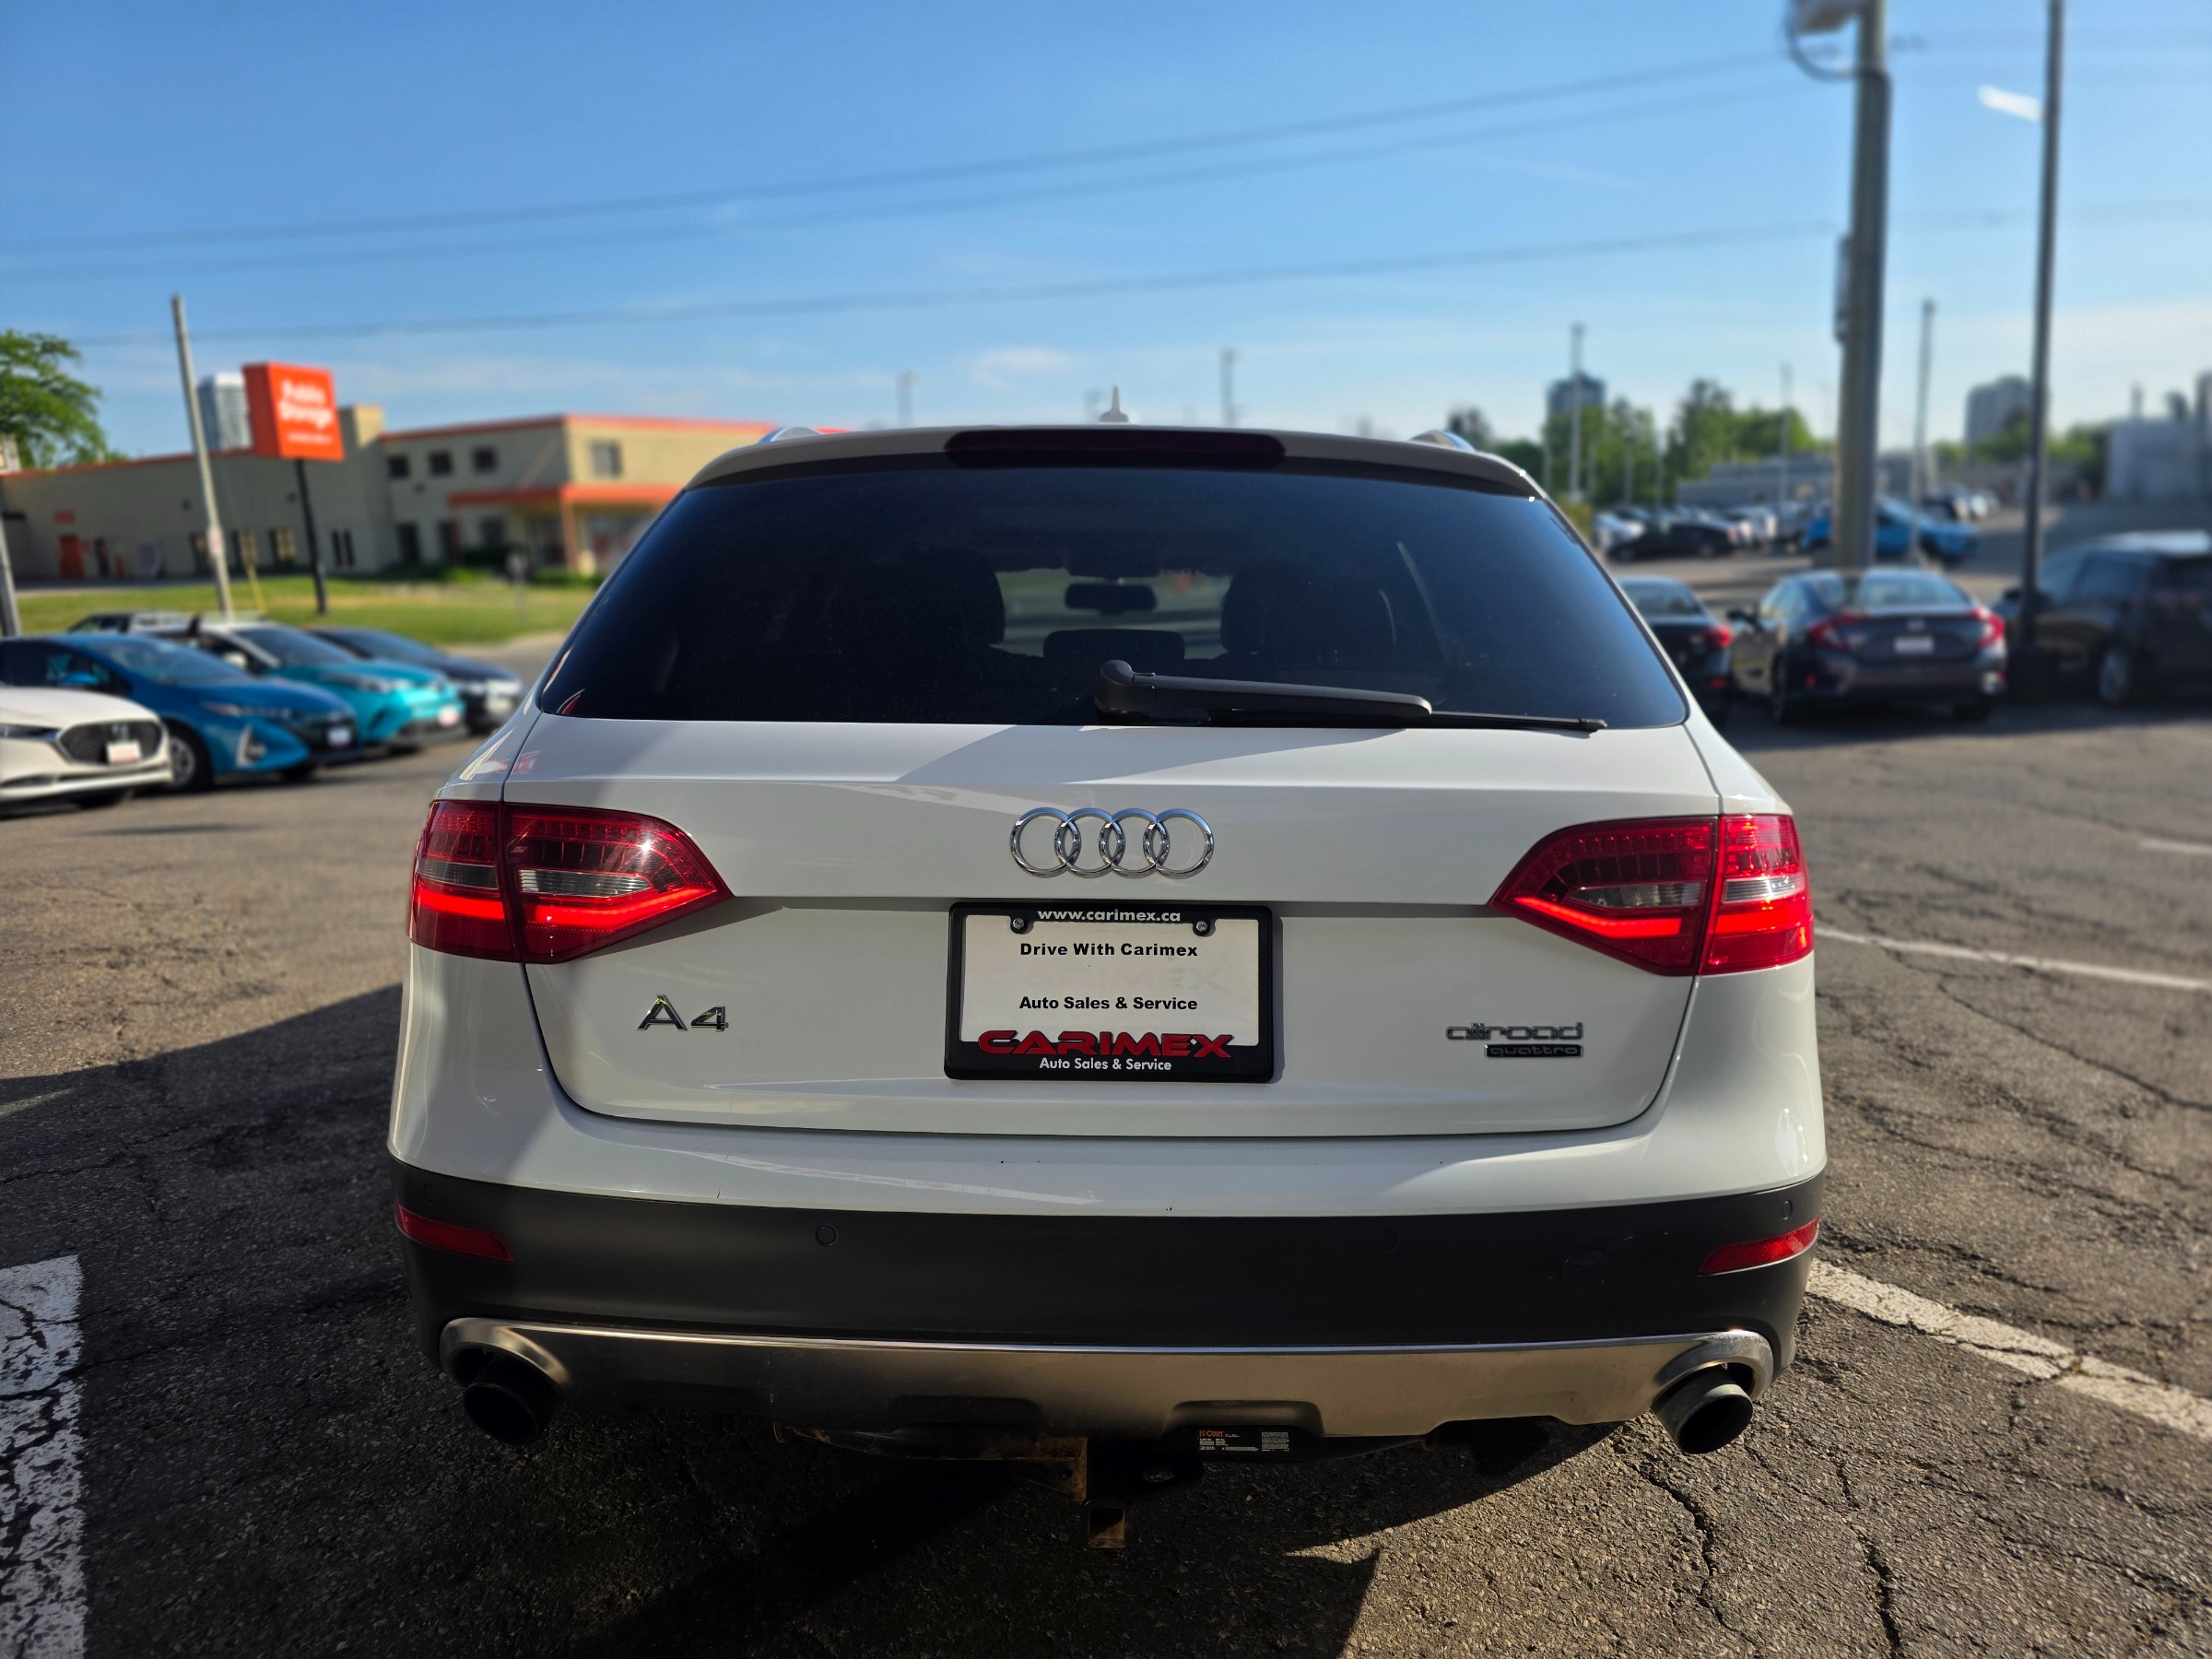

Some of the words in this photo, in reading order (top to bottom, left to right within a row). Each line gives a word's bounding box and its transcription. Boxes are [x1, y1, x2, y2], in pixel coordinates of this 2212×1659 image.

[1037, 909, 1181, 922] www.carimex.ca
[1020, 943, 1068, 956] Drive
[1073, 943, 1115, 956] With
[1120, 943, 1198, 957] Carimex
[1019, 996, 1059, 1009] Auto
[1064, 996, 1110, 1009] Sales
[1115, 996, 1128, 1009] &
[1133, 997, 1198, 1010] Service
[637, 994, 729, 1032] A4
[978, 1030, 1234, 1058] CARIMEX
[1489, 1045, 1579, 1057] quattro
[1039, 1057, 1071, 1069] Auto
[1074, 1058, 1109, 1070] Sales
[1112, 1059, 1122, 1070] &
[1125, 1058, 1172, 1071] Service
